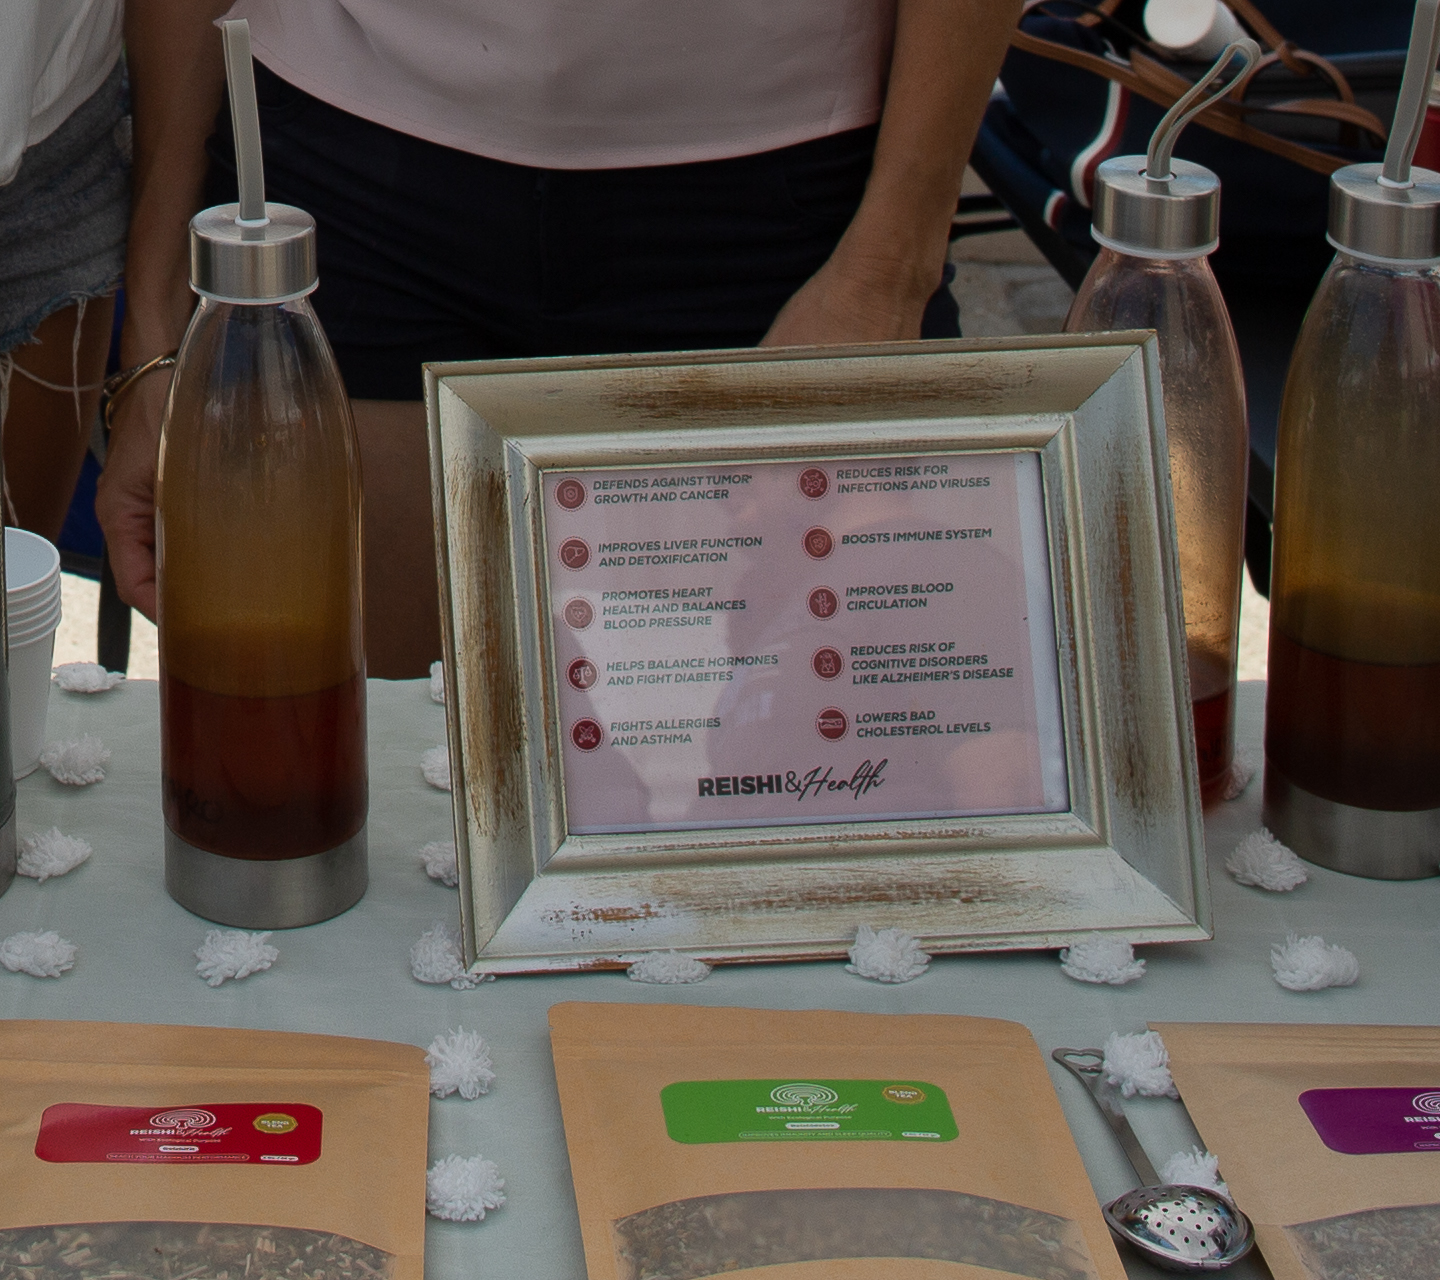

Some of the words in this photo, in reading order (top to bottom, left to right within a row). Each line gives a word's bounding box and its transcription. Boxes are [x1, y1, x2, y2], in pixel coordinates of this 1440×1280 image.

[836, 466, 892, 480] REDUCES
[894, 465, 921, 477] RISK
[923, 464, 949, 475] FOR
[593, 478, 649, 491] DEFENDS
[650, 475, 705, 488] AGAINST
[837, 480, 909, 494] INFECTIONS
[909, 479, 938, 491] AND
[939, 476, 991, 489] VIRUSES
[593, 492, 649, 505] GROWTH
[649, 491, 678, 503] AND
[679, 488, 730, 502] CANCER
[841, 532, 891, 545] BOOSTS
[892, 529, 943, 543] IMMUNE
[944, 527, 993, 541] SYSTEM
[597, 540, 661, 553] IMPROVES
[663, 538, 699, 551] LIVER
[700, 536, 763, 549] FUNCTION
[598, 556, 626, 568] AND
[627, 552, 728, 566] DETOXIFICATION
[601, 588, 670, 601] PROMOTES
[671, 586, 714, 599] HEART
[845, 583, 909, 597] IMPROVES
[910, 581, 955, 594] BLOOD
[602, 604, 650, 616] HEALTH
[651, 602, 679, 613] AND
[681, 598, 747, 612] BALANCES
[846, 597, 928, 612] CIRCULATION
[603, 618, 647, 631] BLOOD
[648, 615, 712, 628] PRESSURE
[850, 643, 907, 656] REDUCES
[908, 642, 936, 654] RISK
[937, 641, 956, 653] OF
[606, 659, 645, 672] HELPS
[647, 657, 705, 670] BALANCE
[707, 653, 779, 667] HORMONES
[851, 657, 917, 671] COGNITIVE
[918, 653, 989, 668] DISORDERS
[606, 675, 635, 687] AND
[636, 673, 673, 685] FIGHT
[674, 670, 734, 684] DIABETES
[851, 673, 879, 686] LIKE
[962, 667, 1014, 680] DISEASE
[610, 720, 654, 732] FIGHTS
[654, 716, 722, 730] ALLERGIES
[855, 711, 908, 724] LOWERS
[909, 709, 936, 722] BAD
[856, 724, 944, 739] CHOLESTEROL
[945, 721, 992, 735] LEVELS
[610, 735, 639, 747] AND
[639, 733, 693, 745] ASTHMA
